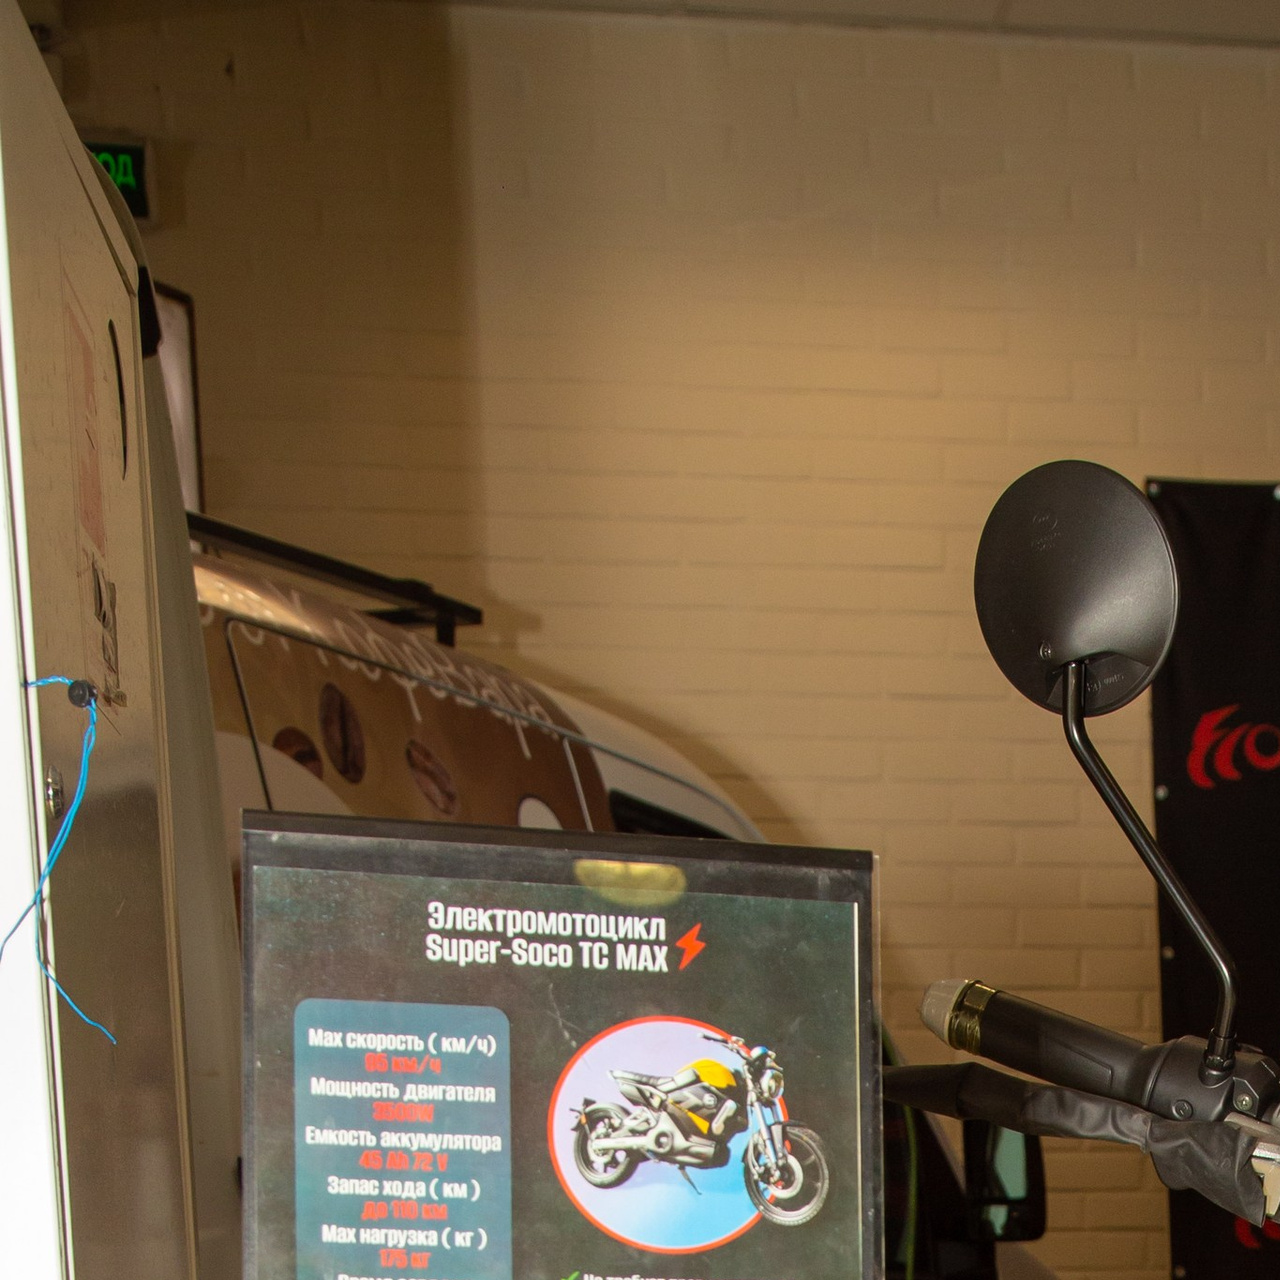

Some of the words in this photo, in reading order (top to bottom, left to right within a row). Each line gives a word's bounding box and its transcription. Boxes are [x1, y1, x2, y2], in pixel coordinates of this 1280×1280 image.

[92, 151, 137, 190] ОД
[427, 901, 667, 942] Электромотоцикл
[425, 933, 573, 968] Super-Soco
[579, 941, 609, 970] TC
[615, 943, 669, 973] MAX
[346, 1032, 425, 1052] скорость
[310, 1077, 400, 1100] Мощность
[403, 1083, 496, 1103] двигателя
[305, 1125, 377, 1147] Емкость
[380, 1131, 502, 1155] аккумулятора
[358, 1150, 383, 1170] 45
[386, 1152, 410, 1171] Ah
[412, 1152, 433, 1172] 72
[437, 1153, 449, 1172] V
[327, 1175, 380, 1196] Запас
[383, 1180, 426, 1200] хода
[361, 1201, 388, 1221] до
[391, 1200, 419, 1219] 110
[422, 1204, 447, 1221] км
[360, 1228, 438, 1248] нагрузка
[379, 1248, 408, 1269] 175
[411, 1252, 431, 1269] кг
